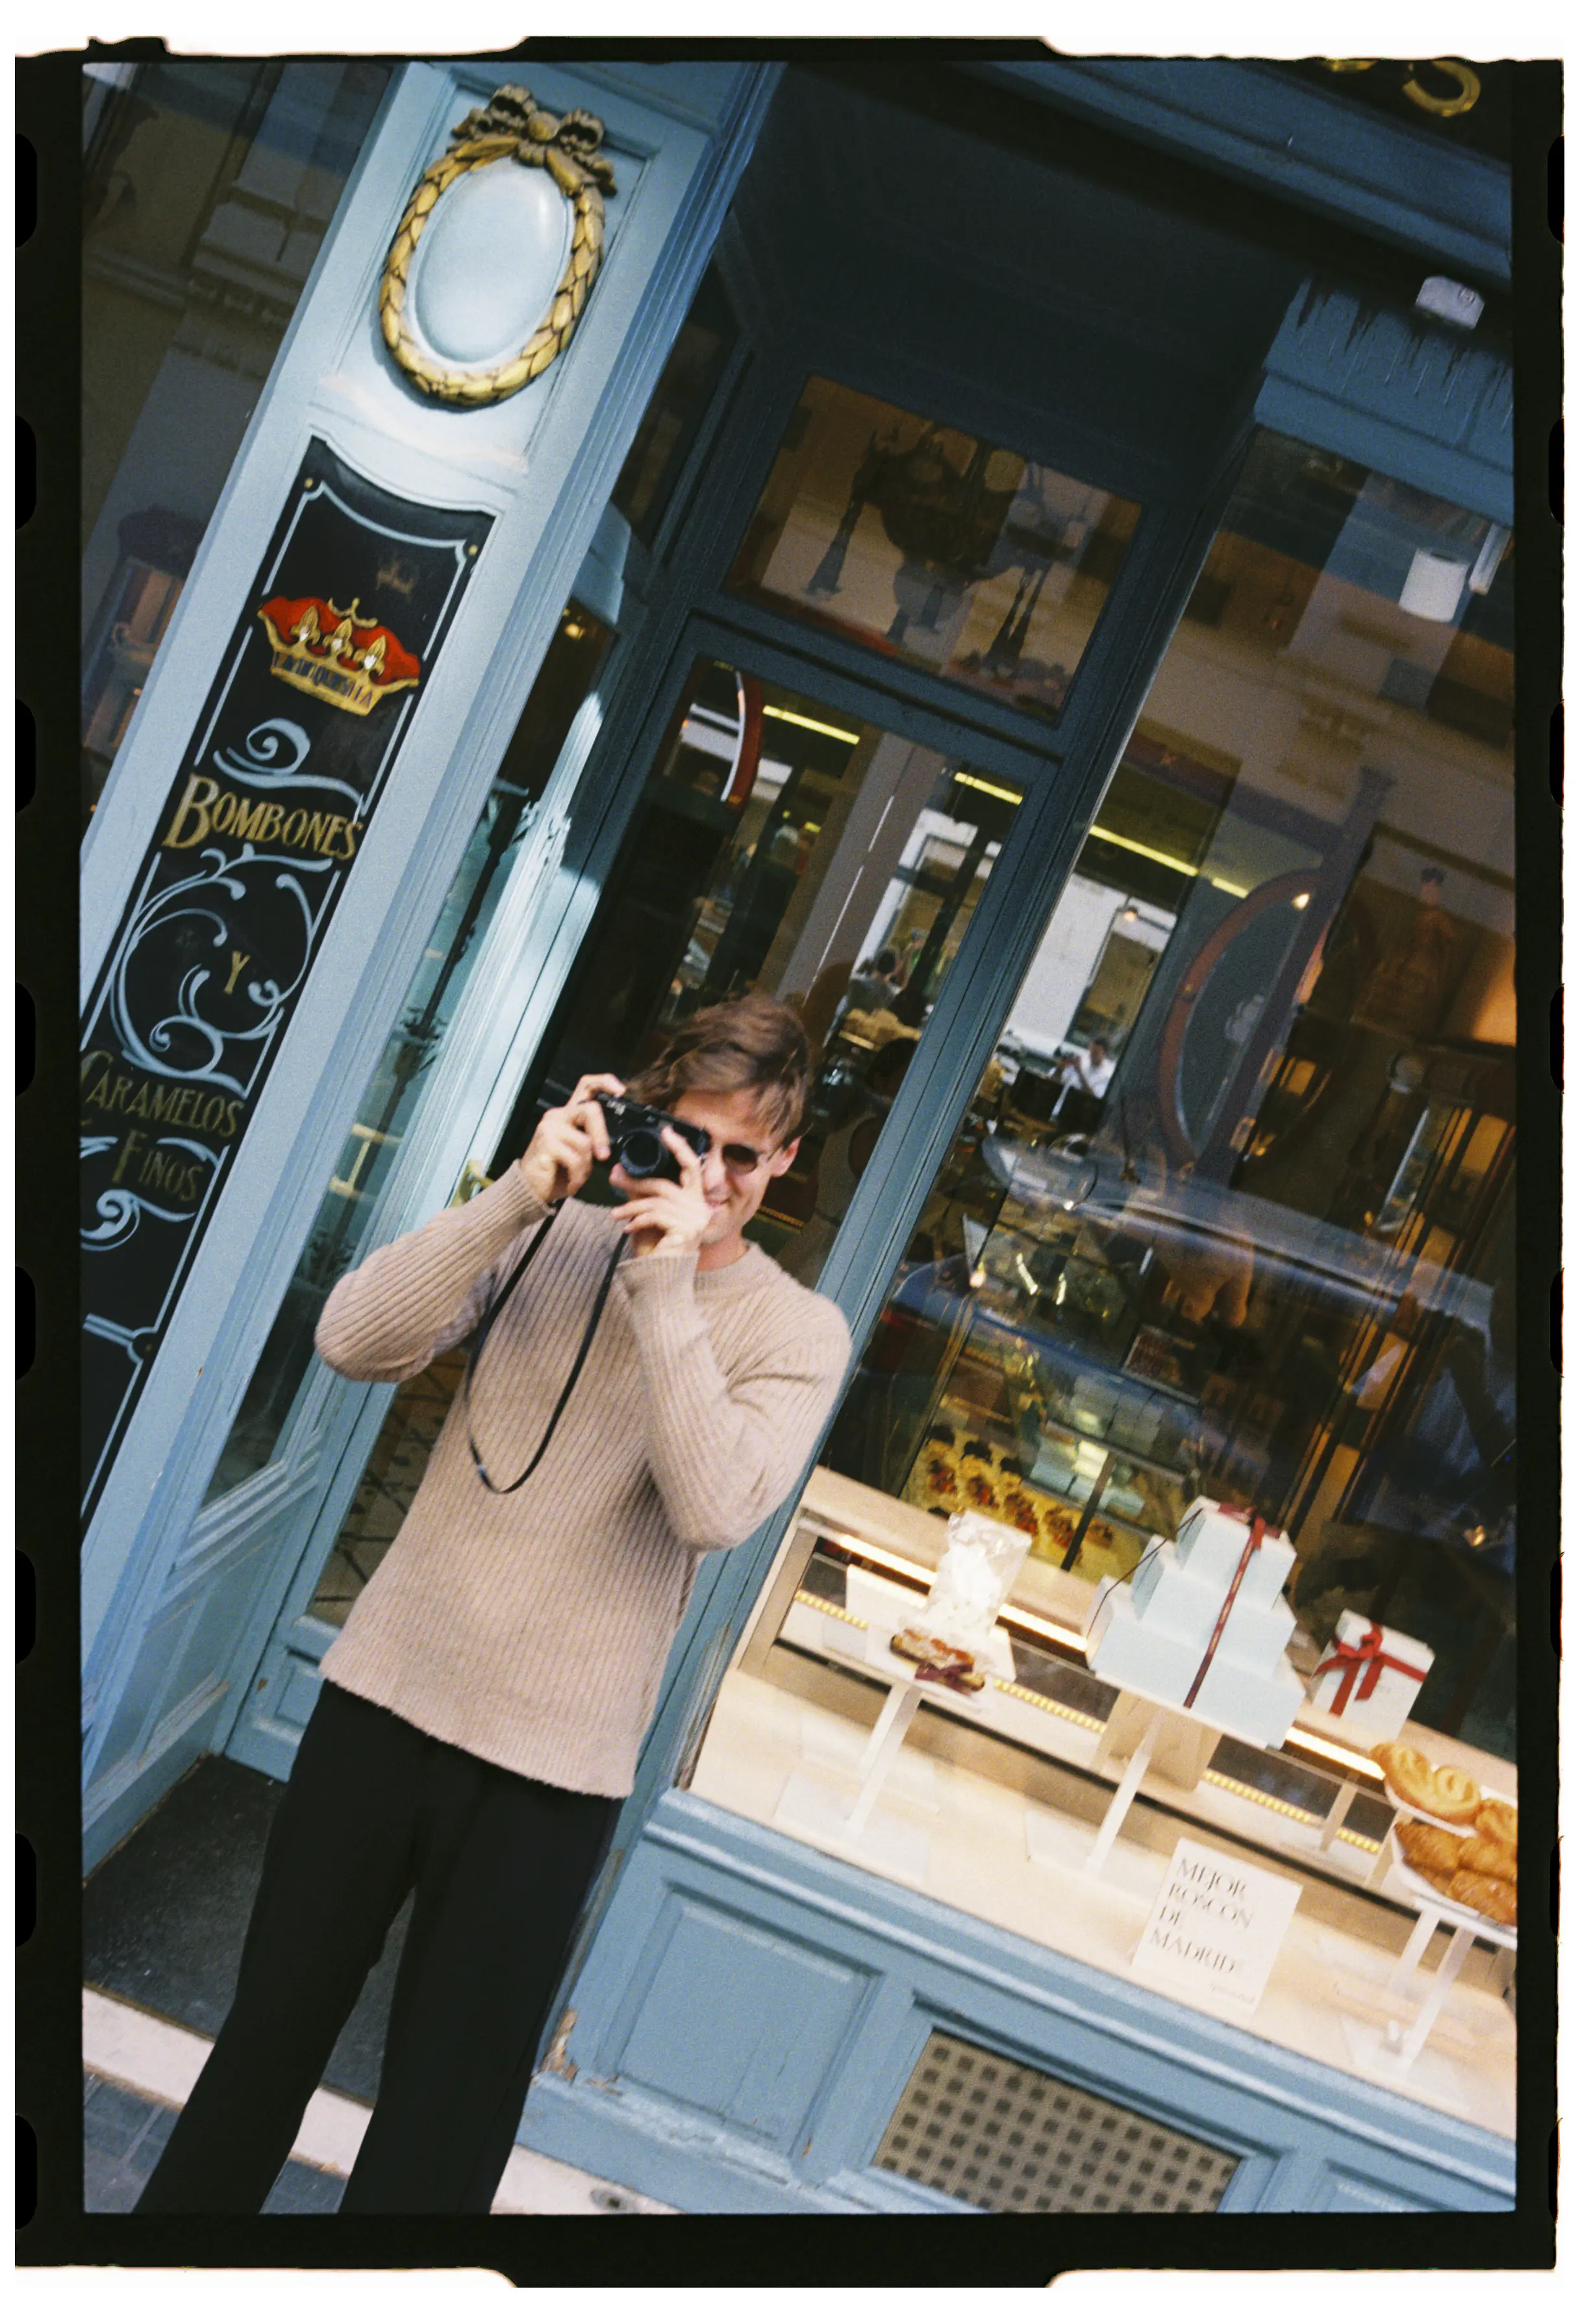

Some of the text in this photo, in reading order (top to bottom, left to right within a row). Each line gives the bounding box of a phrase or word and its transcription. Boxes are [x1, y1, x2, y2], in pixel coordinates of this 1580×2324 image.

[162, 772, 364, 861] BOMBONES
[223, 950, 251, 996] Y
[111, 1129, 205, 1202] FINOS
[1176, 1858, 1247, 1901] MEJOR
[1158, 1905, 1185, 1930] DE
